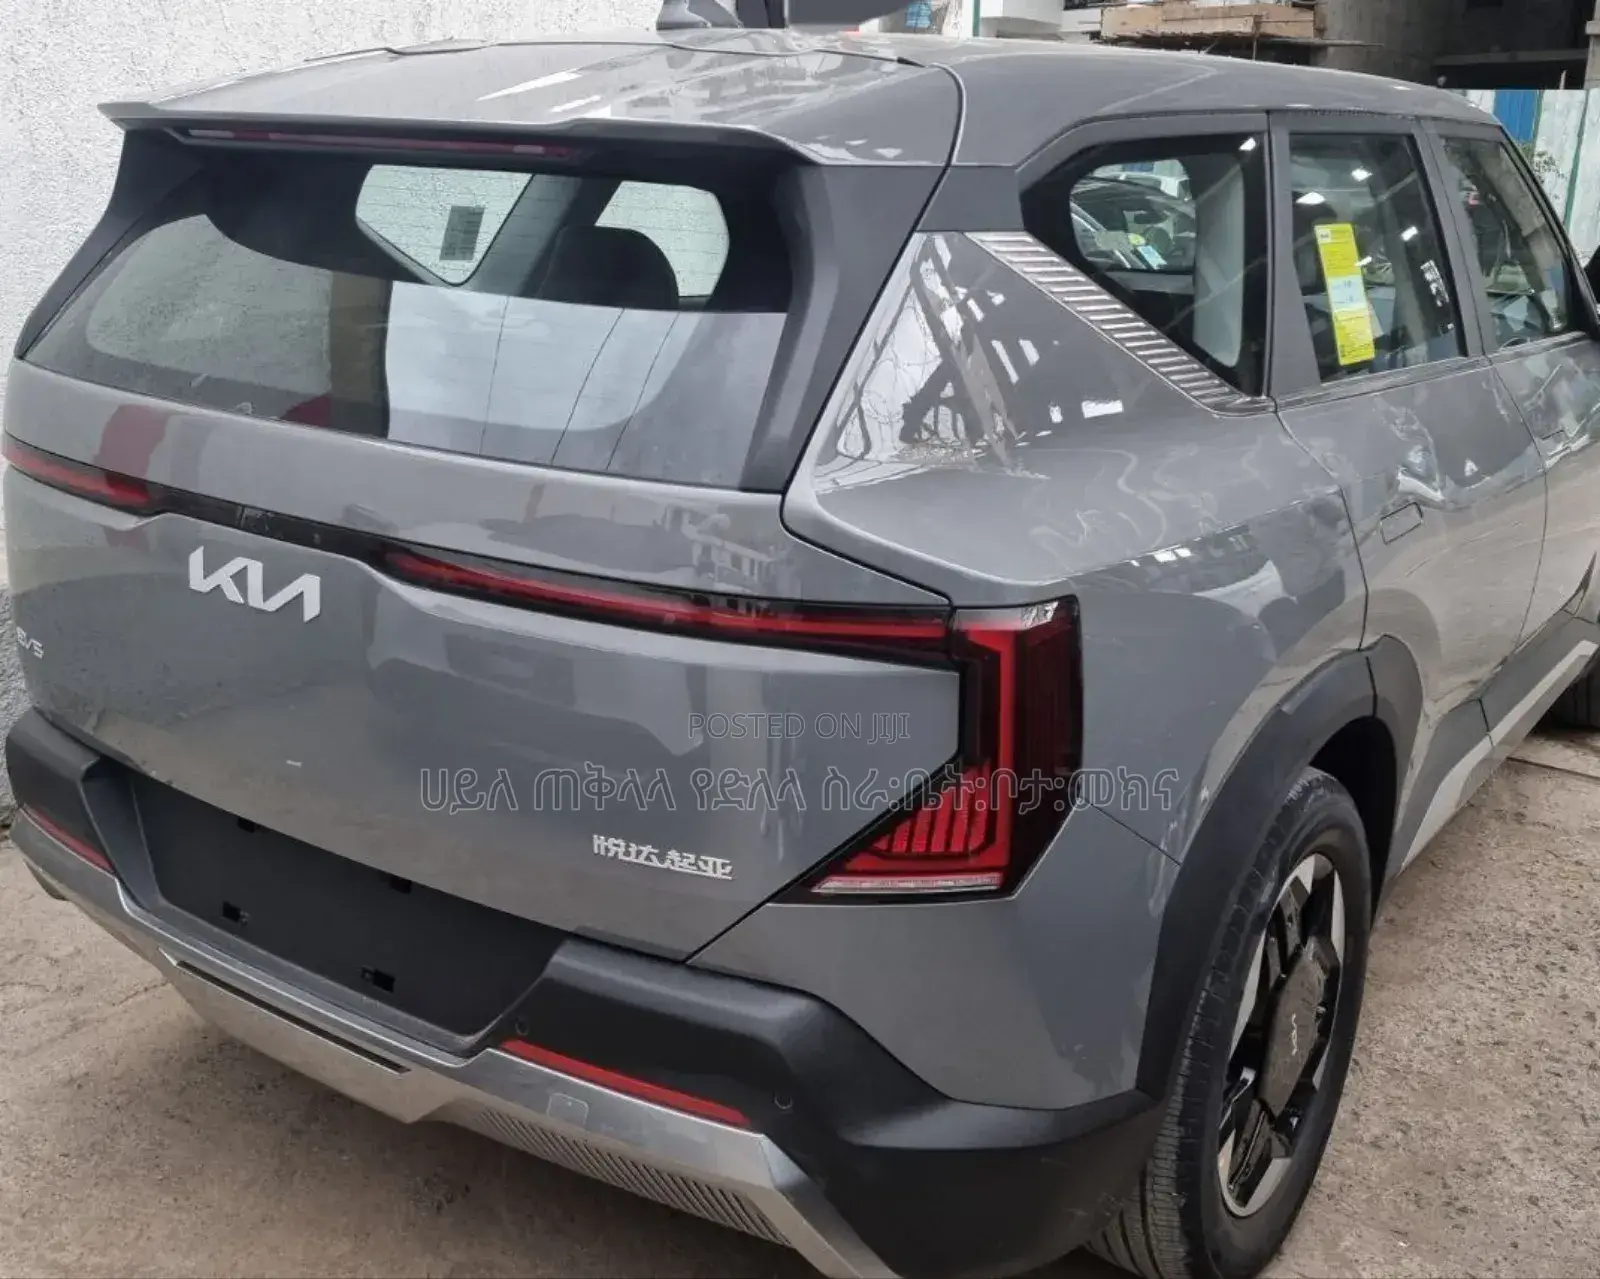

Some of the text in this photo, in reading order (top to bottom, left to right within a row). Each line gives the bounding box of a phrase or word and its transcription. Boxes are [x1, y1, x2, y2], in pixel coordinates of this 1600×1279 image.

[189, 546, 320, 622] KIA
[592, 834, 733, 881] 悦达起亚
